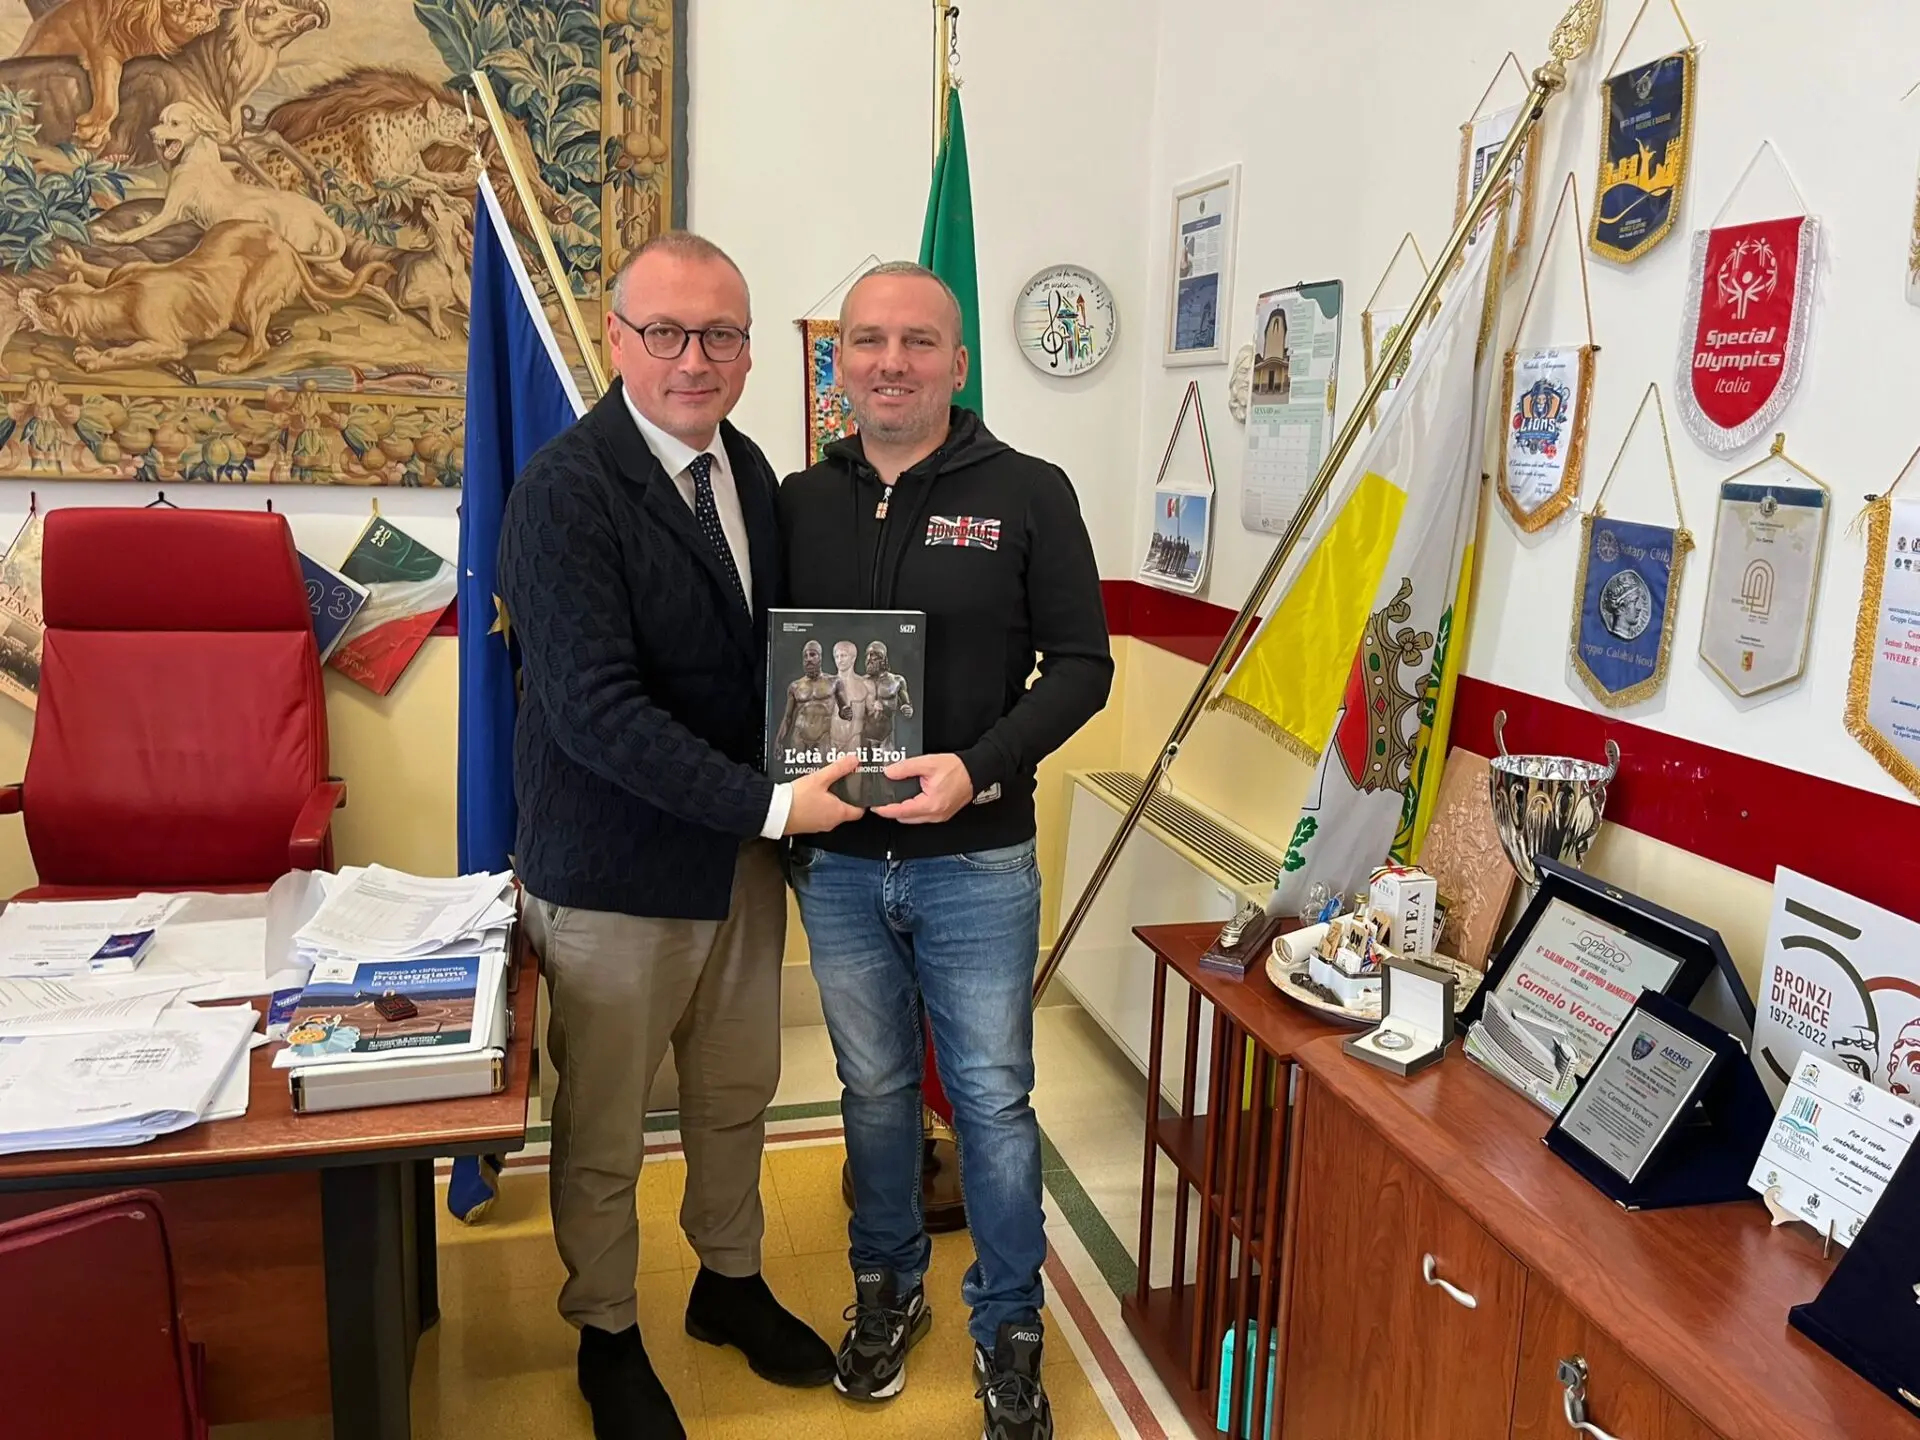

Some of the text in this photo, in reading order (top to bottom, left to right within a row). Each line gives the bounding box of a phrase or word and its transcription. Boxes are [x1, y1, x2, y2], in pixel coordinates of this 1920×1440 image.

[1705, 326, 1776, 349] Special
[1694, 350, 1782, 372] Olympics
[1714, 376, 1751, 394] Italia
[1520, 418, 1556, 432] LIONS
[1649, 546, 1671, 563] Club
[784, 747, 823, 764] L'età
[871, 746, 907, 763] Eroi
[784, 766, 794, 775] LA
[1580, 936, 1625, 964] OPPIDO
[372, 970, 468, 982] Proteggiamo
[385, 979, 408, 987] sua
[1586, 972, 1607, 989] OPPIDO
[1773, 965, 1832, 1010] BRONZI
[1517, 973, 1567, 1010] Carmelo
[1771, 983, 1830, 1030] DI RIACE
[1769, 1005, 1827, 1048] 1972-2022
[1660, 1045, 1694, 1070] AREMES
[1607, 1091, 1632, 1113] Carmelo
[1631, 1107, 1654, 1129] Versace
[1772, 1131, 1811, 1160] CULTURA
[1778, 1122, 1816, 1148] SETTIMANA
